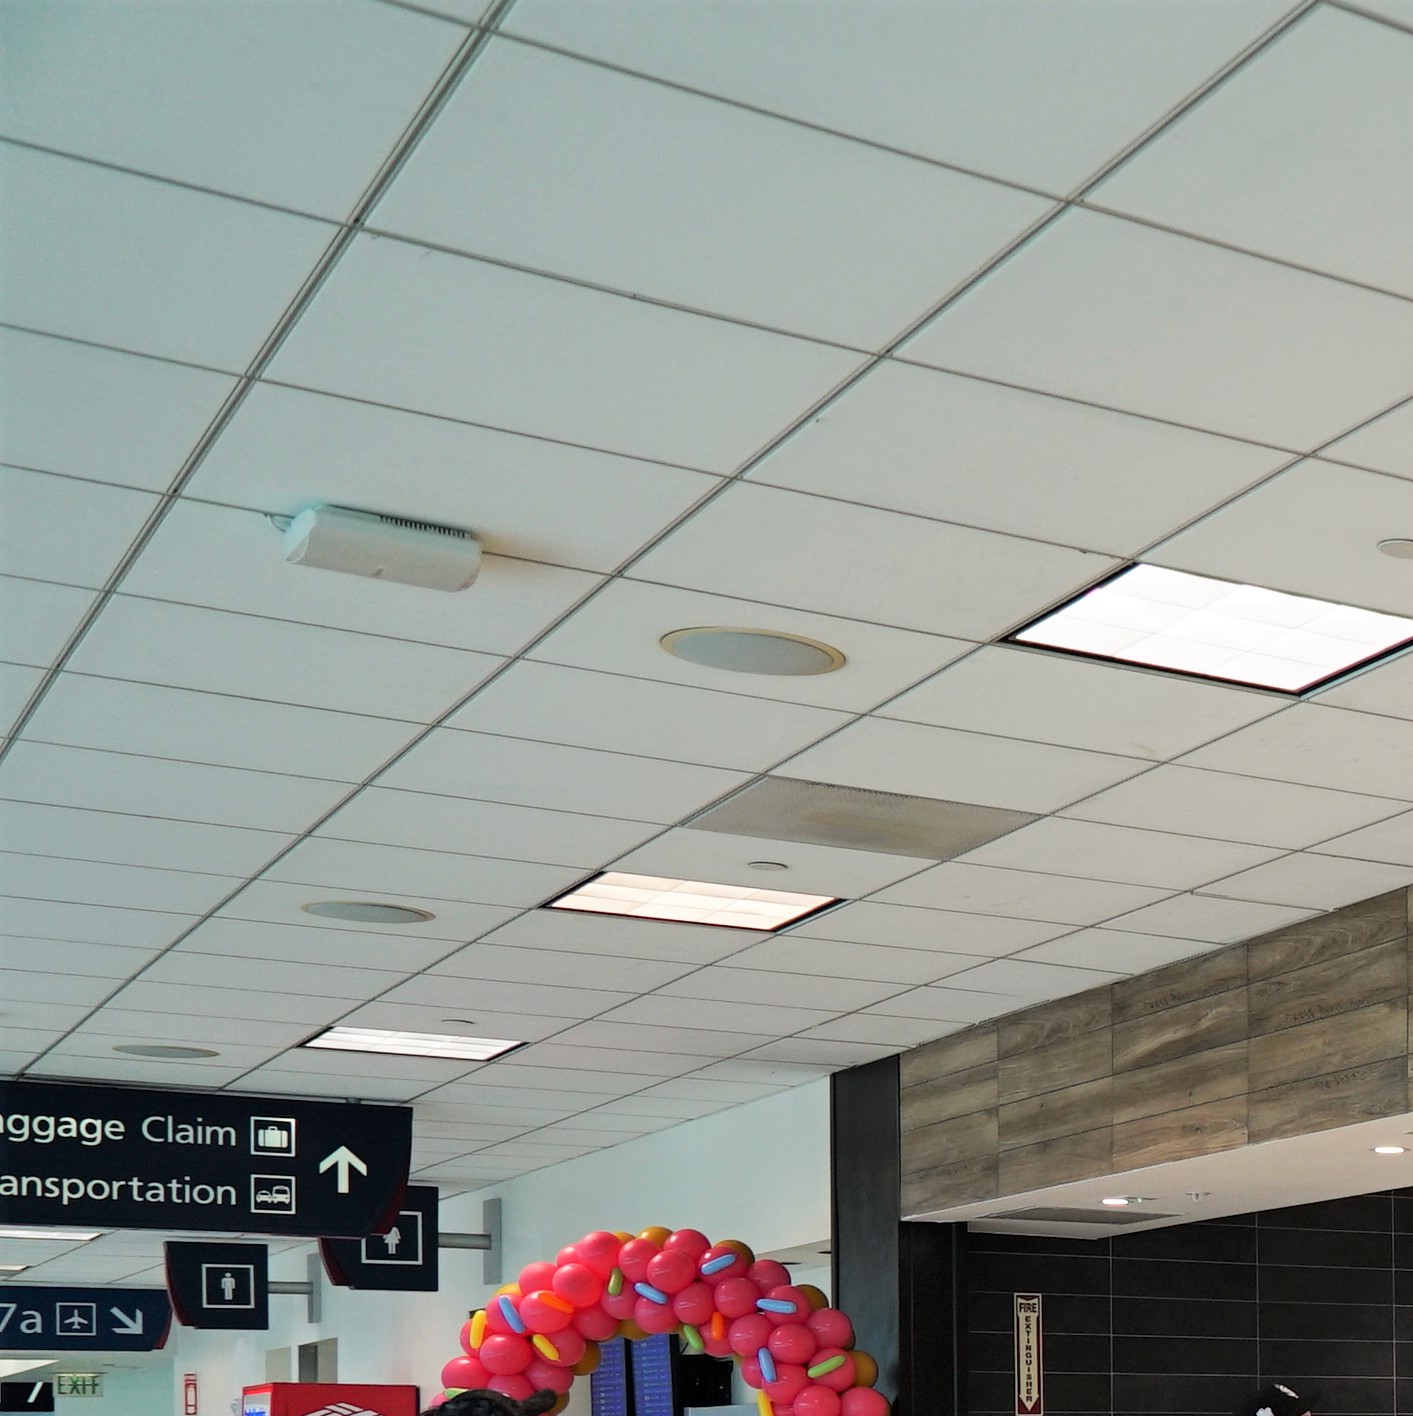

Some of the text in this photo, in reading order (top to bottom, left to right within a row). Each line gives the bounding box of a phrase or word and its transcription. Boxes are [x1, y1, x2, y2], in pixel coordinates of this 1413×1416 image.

[141, 1115, 236, 1147] Claim
[1019, 1302, 1037, 1313] FIRE
[1024, 1315, 1033, 1402] EXTINGUISHER
